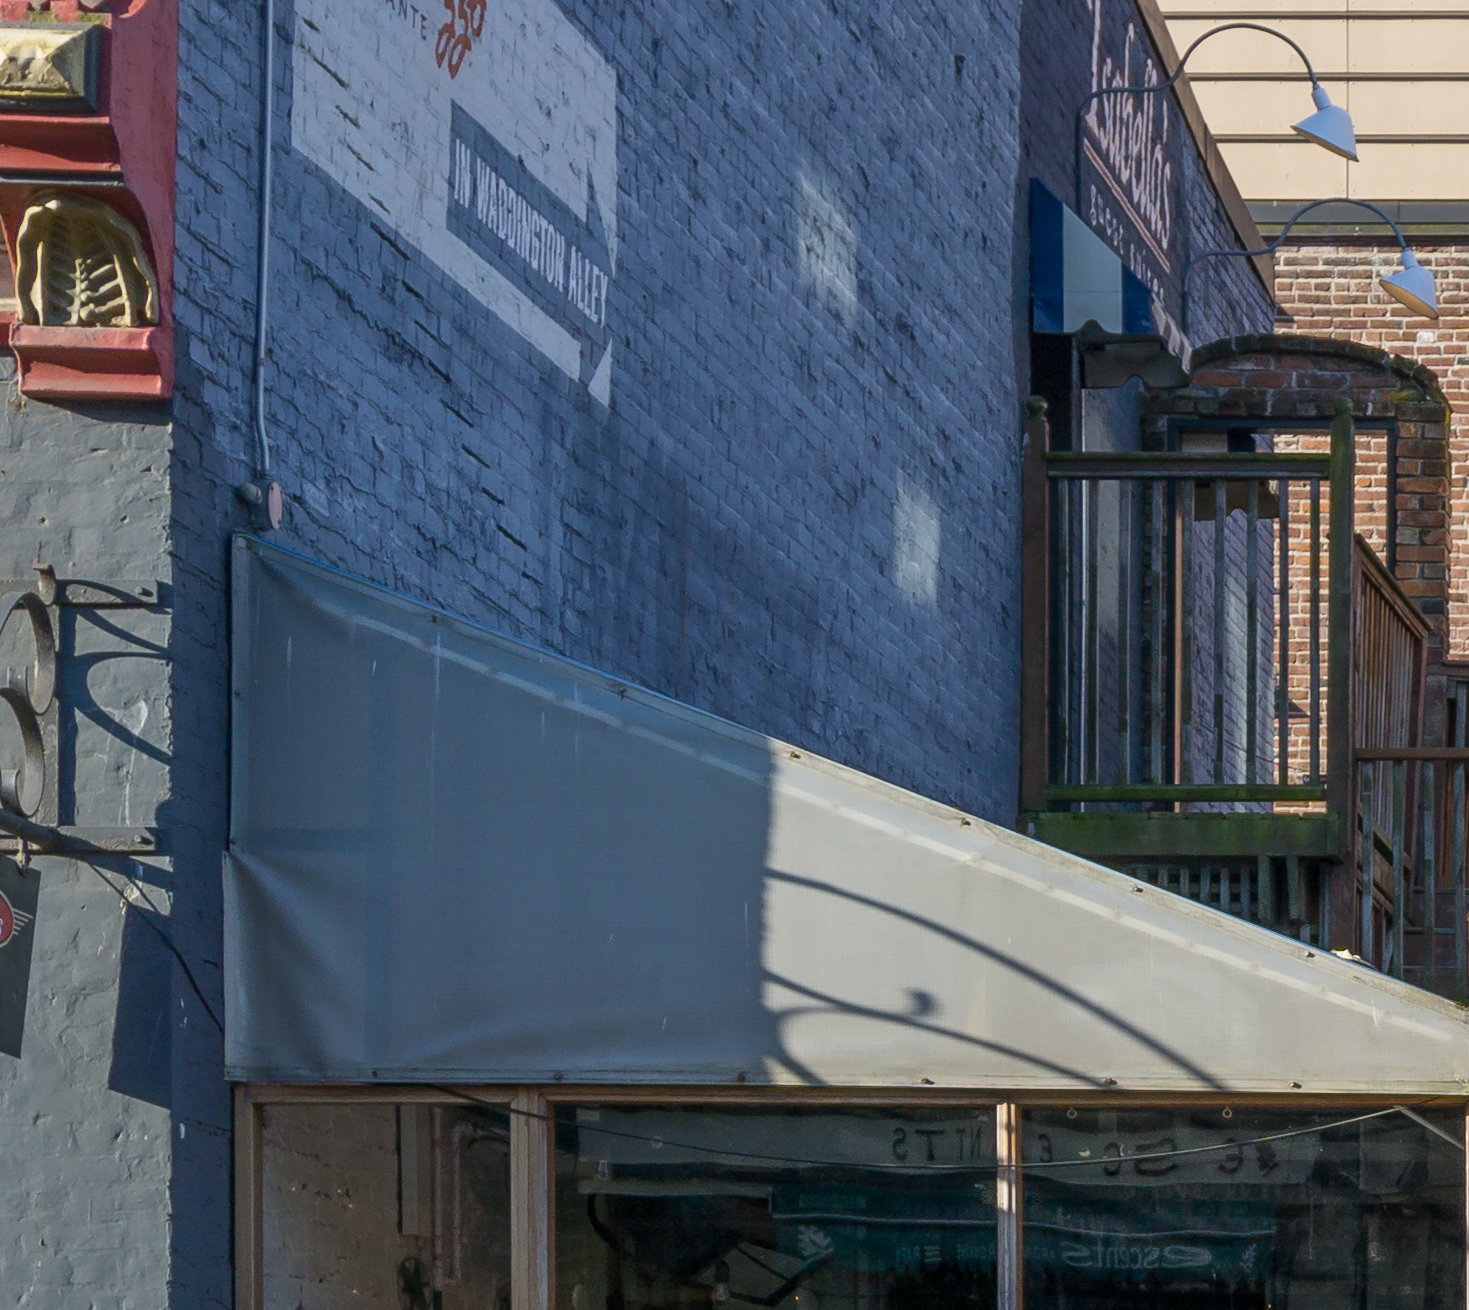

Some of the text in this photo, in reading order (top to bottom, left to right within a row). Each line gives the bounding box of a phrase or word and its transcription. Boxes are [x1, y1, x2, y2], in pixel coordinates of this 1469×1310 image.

[453, 137, 609, 330] IN WADDINGTON ALLEY
[1089, 183, 1124, 255] guest
